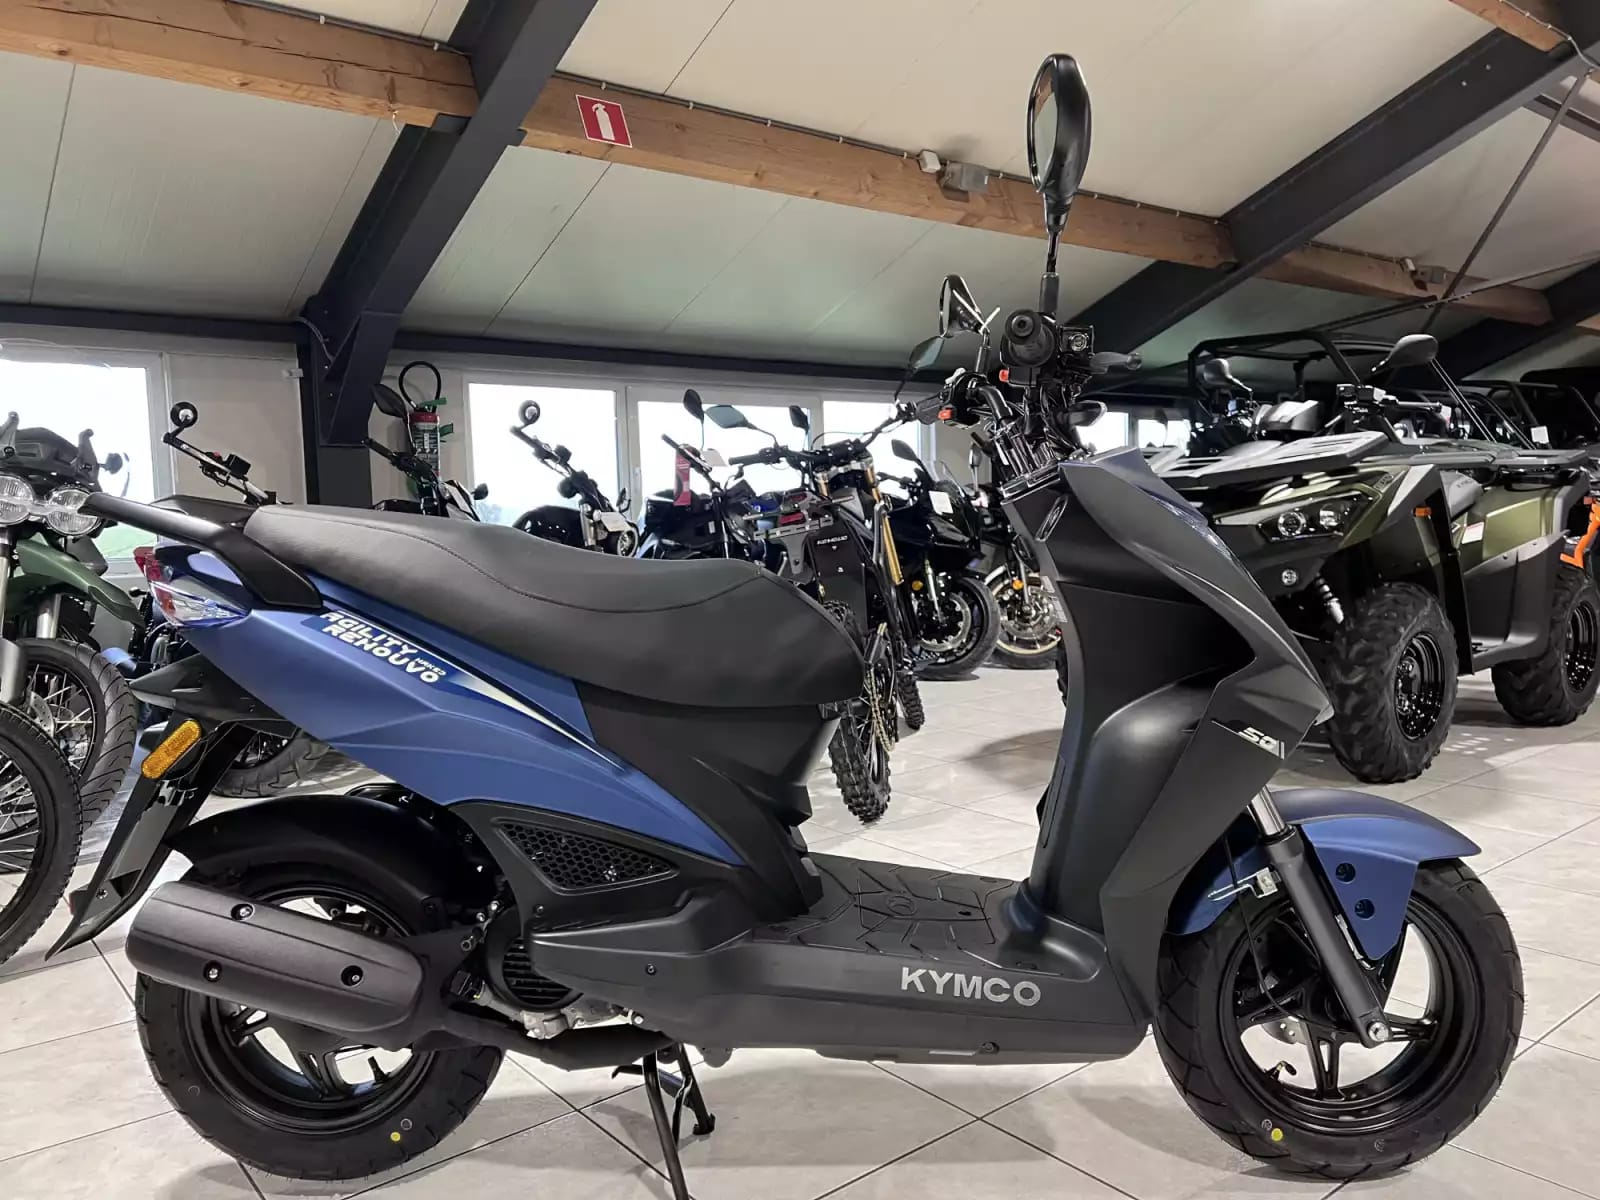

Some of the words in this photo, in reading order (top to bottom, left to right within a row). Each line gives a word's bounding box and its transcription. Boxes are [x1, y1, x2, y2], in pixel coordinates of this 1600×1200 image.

[320, 611, 418, 655] AGILITY
[322, 624, 439, 683] RENOUVO
[901, 967, 1041, 1006] KYMCO
